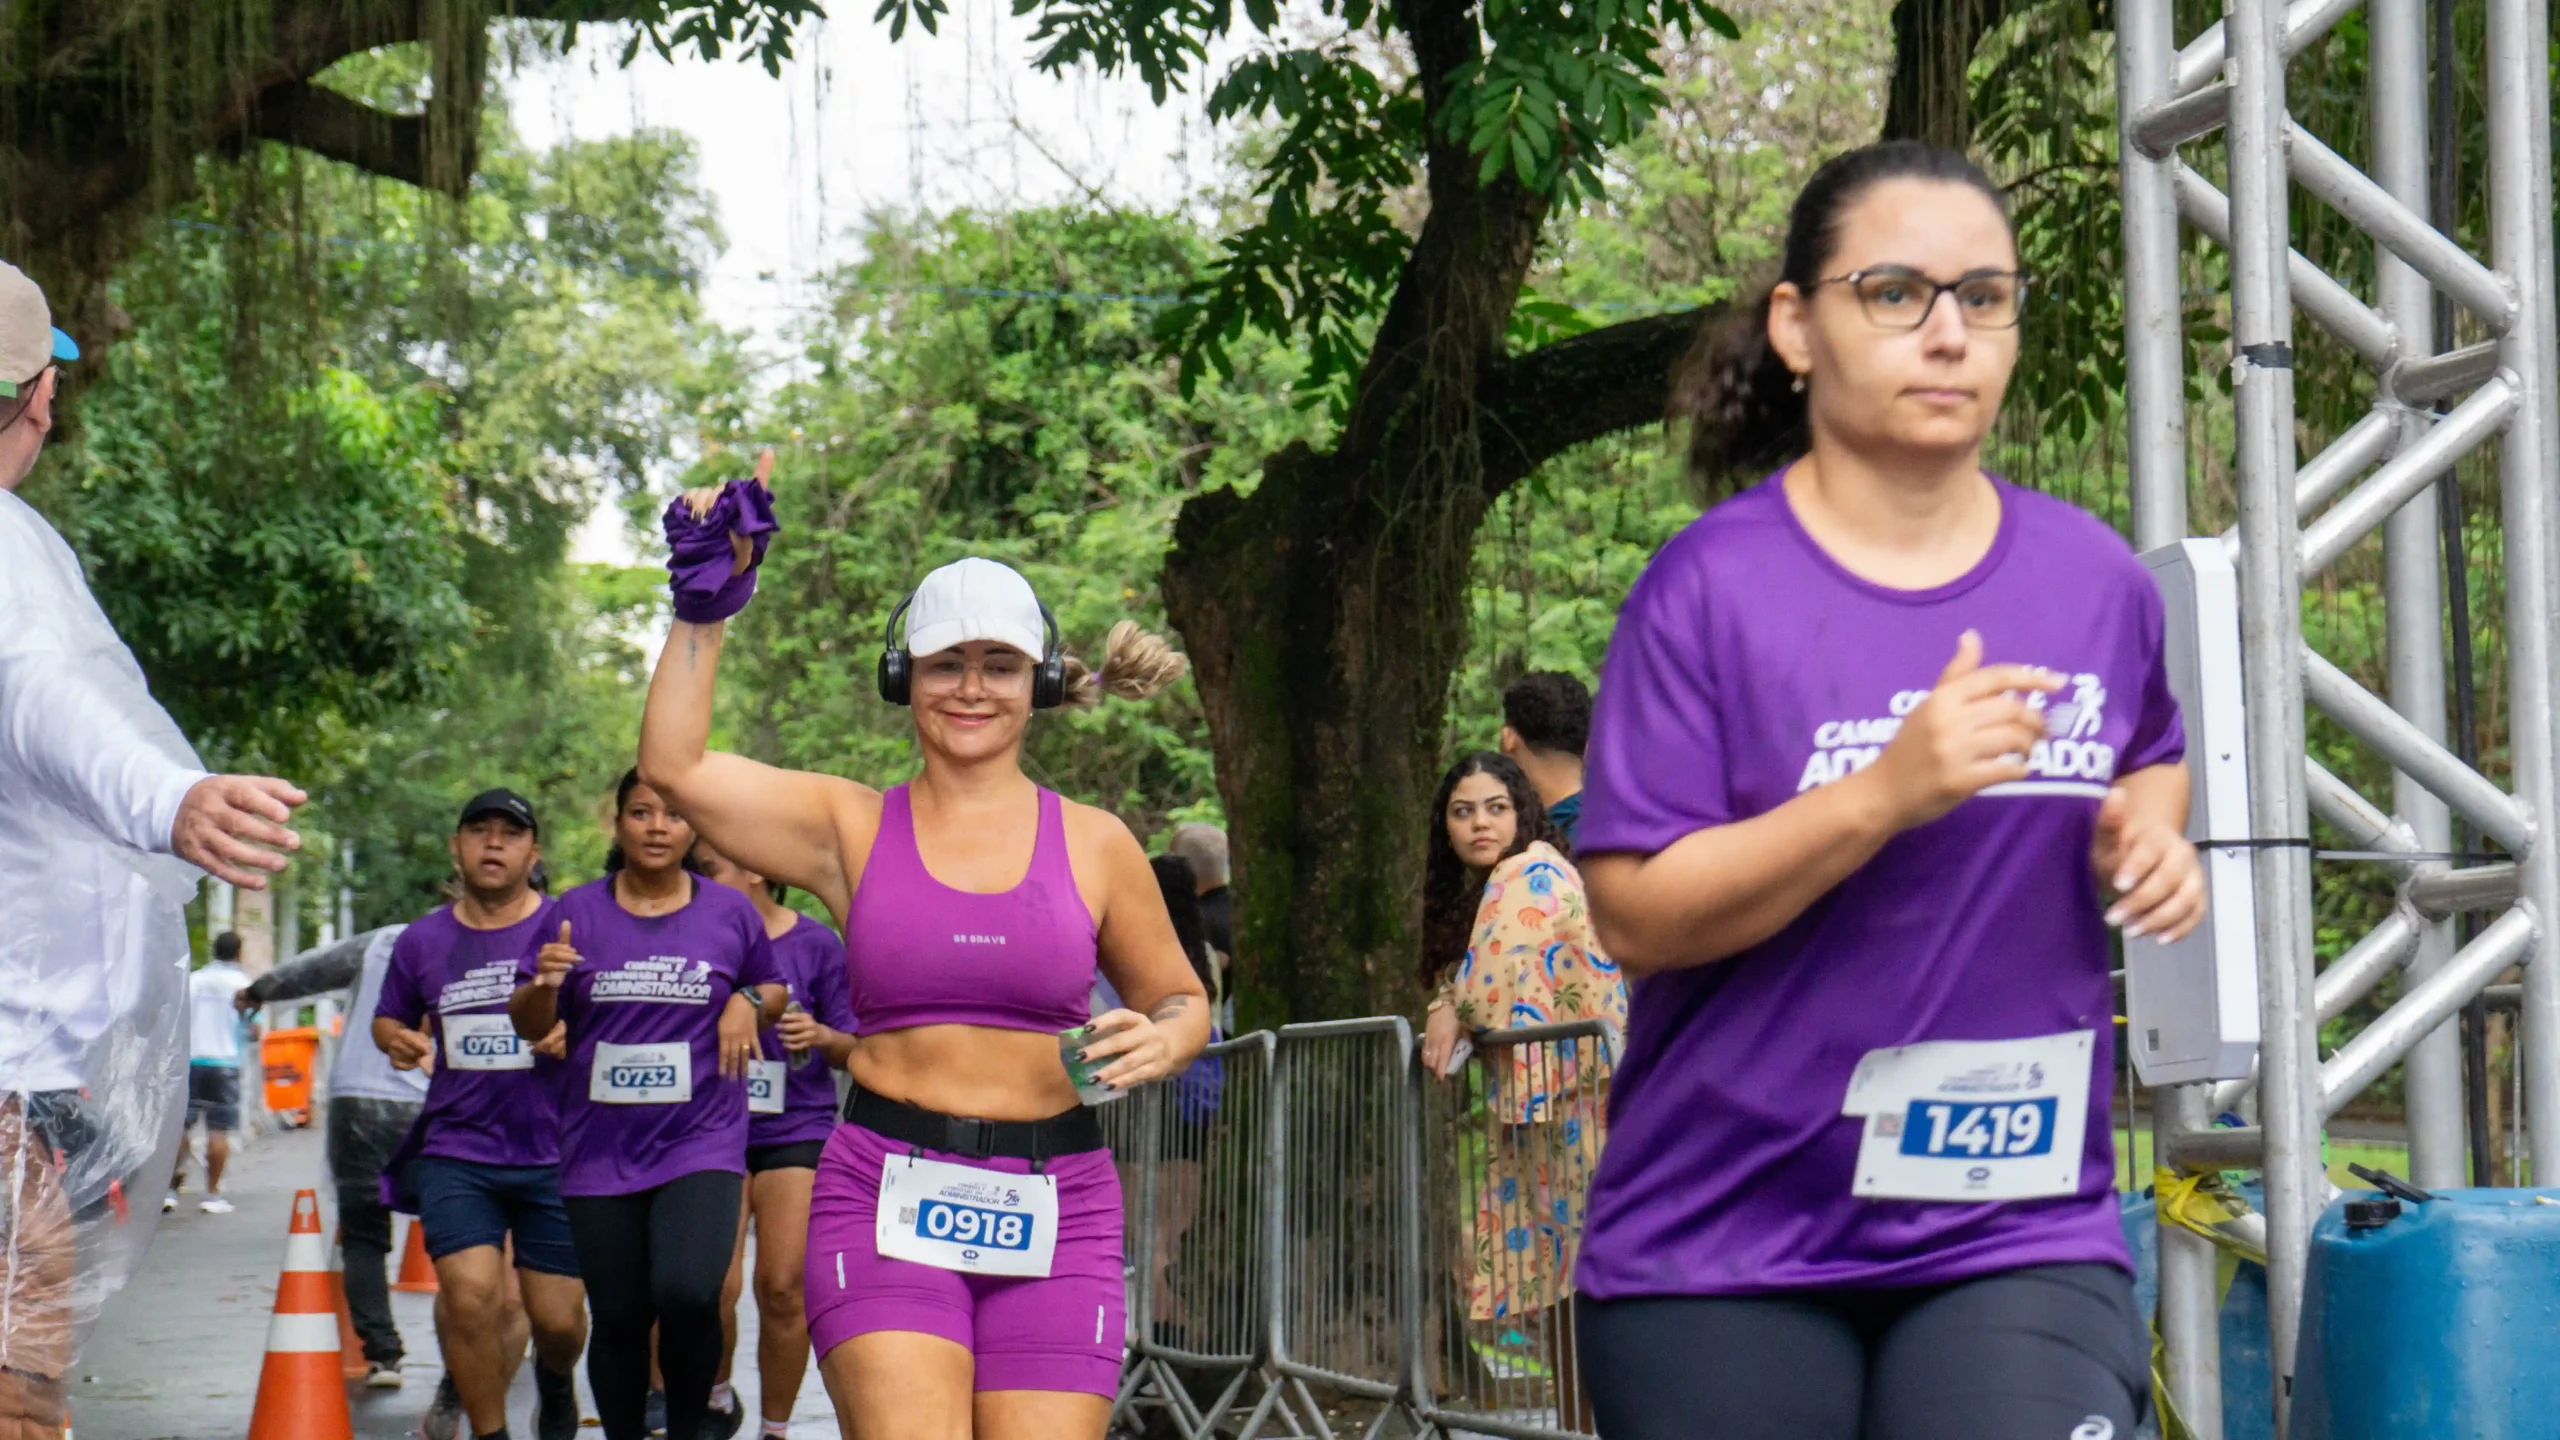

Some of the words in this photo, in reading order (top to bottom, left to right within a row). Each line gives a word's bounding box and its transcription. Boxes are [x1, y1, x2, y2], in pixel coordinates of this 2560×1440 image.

[953, 933, 967, 943] BE
[969, 934, 1006, 945] BRAVE
[590, 980, 712, 998] ADMINISTRADOR
[466, 1036, 515, 1054] 0761
[614, 1067, 673, 1086] 0732
[1926, 1103, 2043, 1156] 1419
[926, 1204, 1024, 1248] 0918
